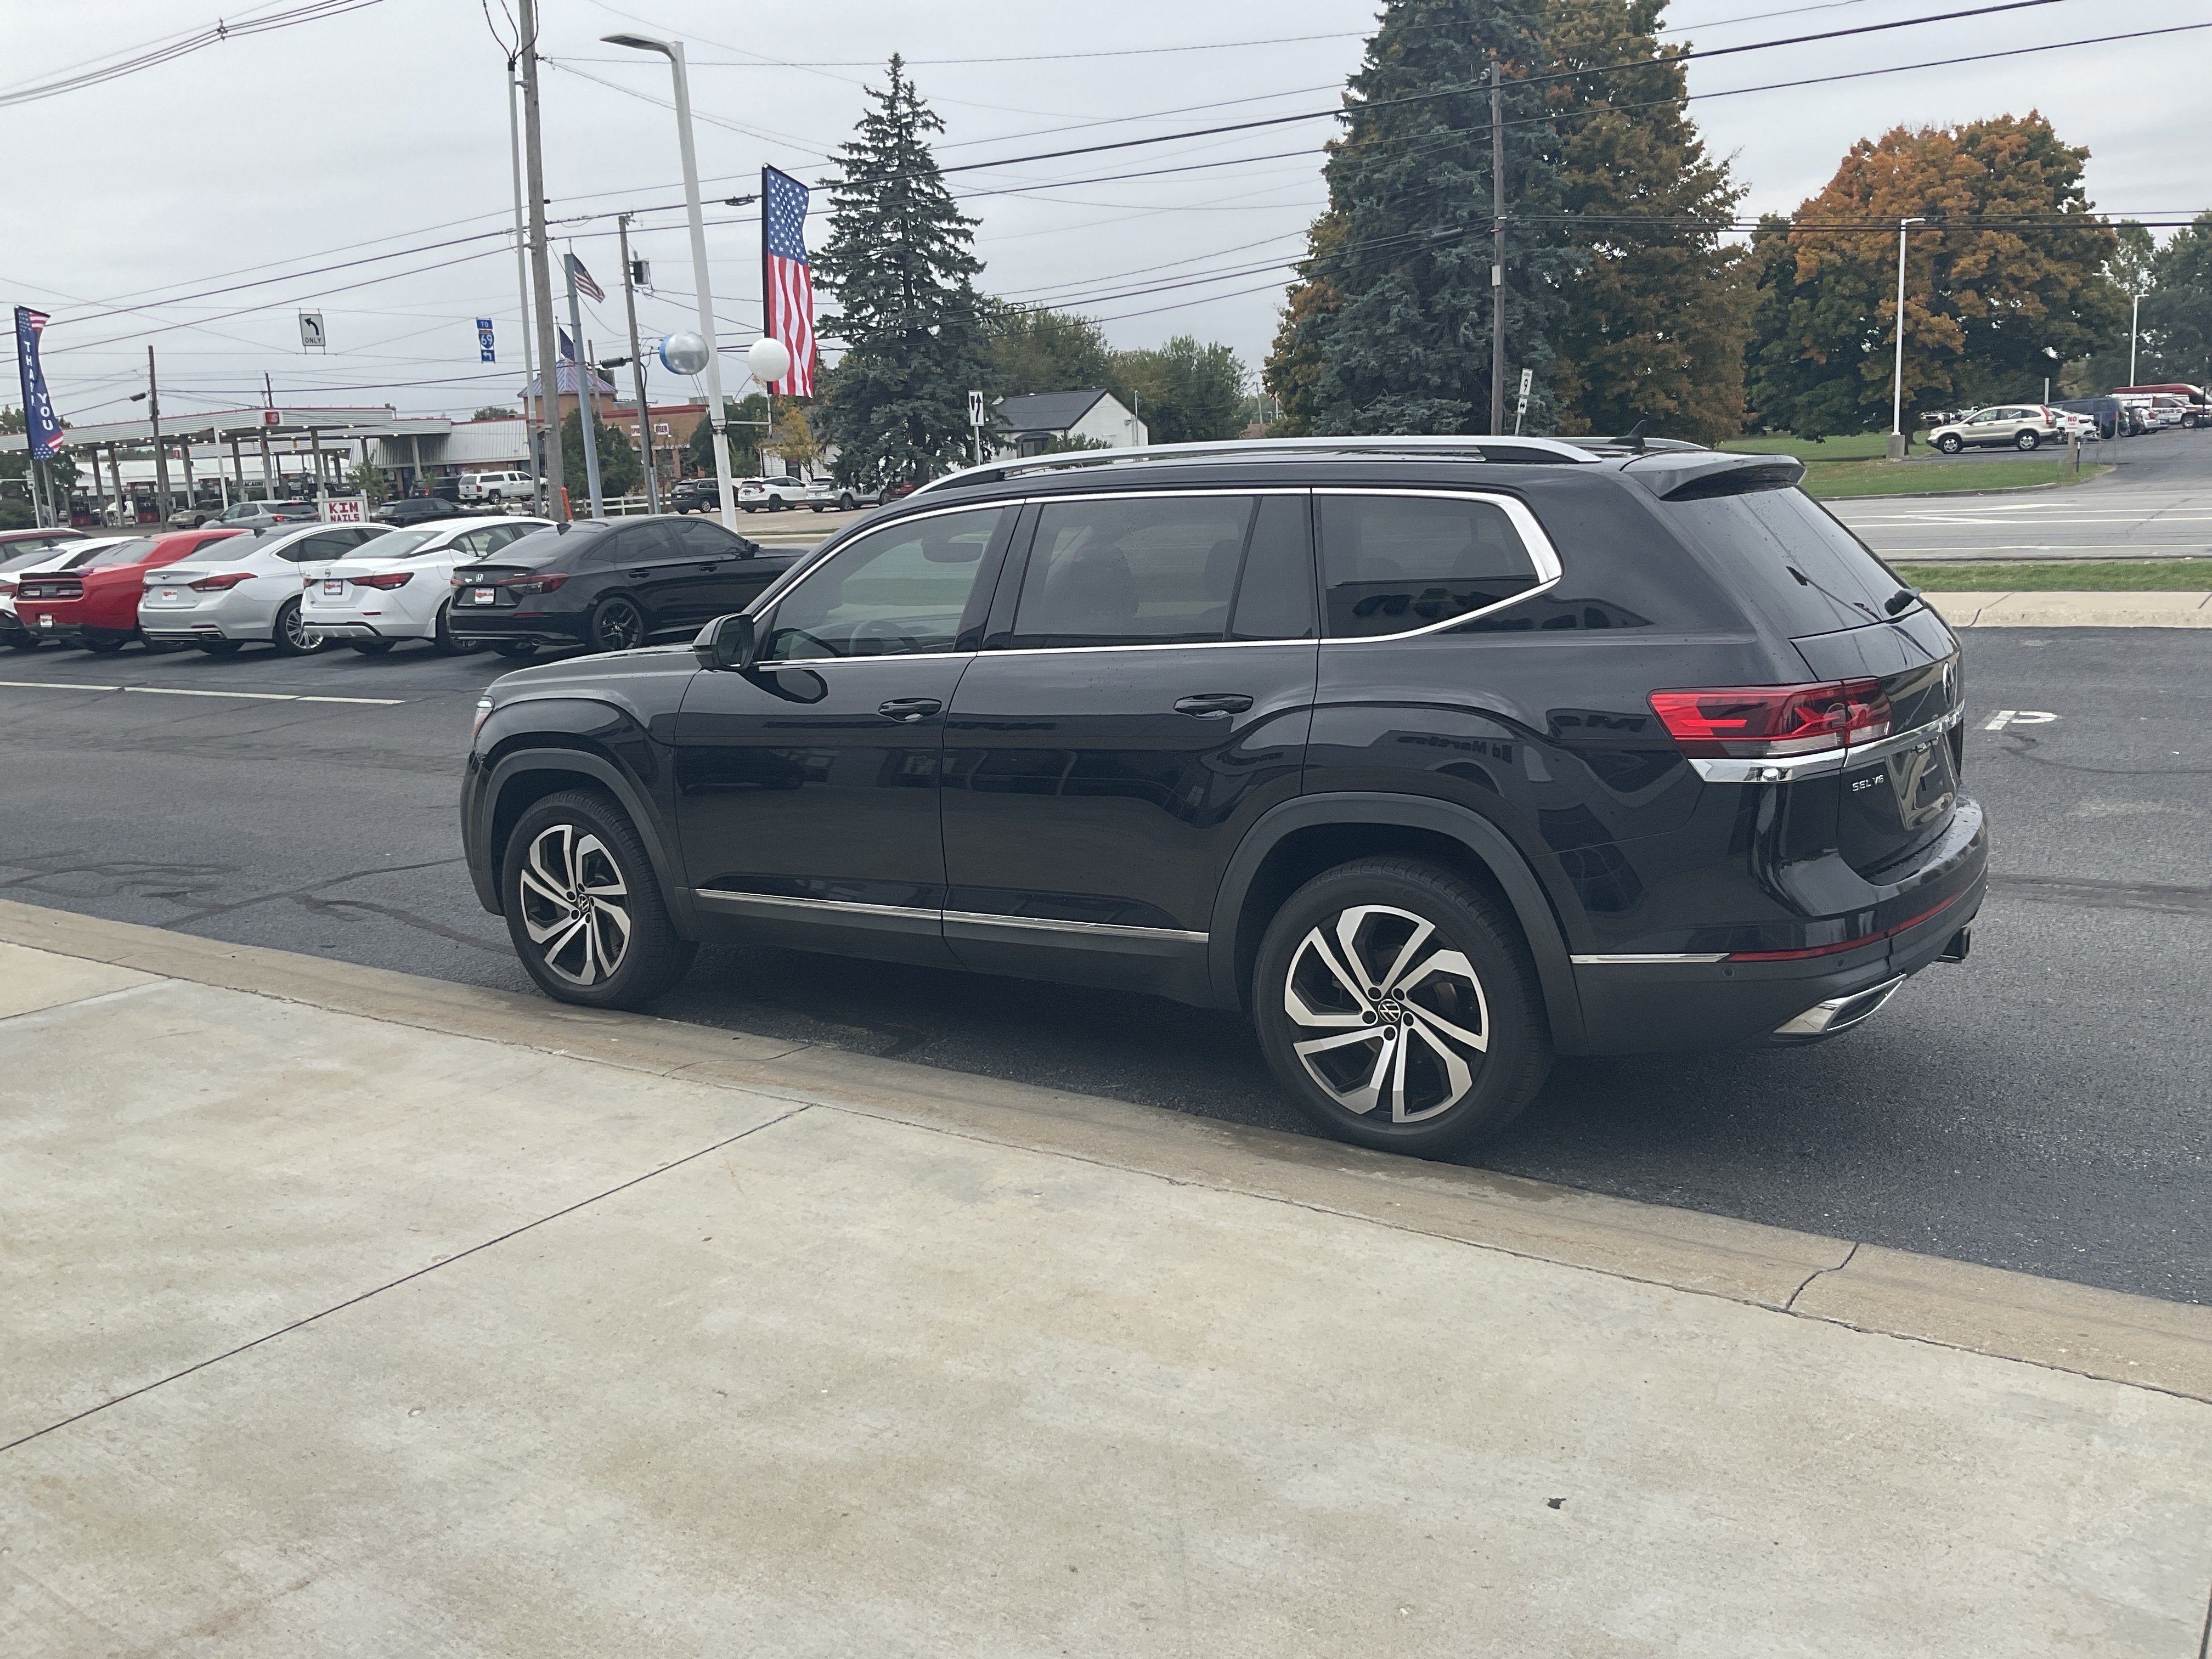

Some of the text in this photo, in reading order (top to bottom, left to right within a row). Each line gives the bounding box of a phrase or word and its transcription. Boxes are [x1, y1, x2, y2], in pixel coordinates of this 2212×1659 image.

[481, 335, 493, 345] 69
[24, 341, 54, 431] THAN YOU
[329, 502, 359, 514] KIM
[1852, 780, 1871, 792] SEL
